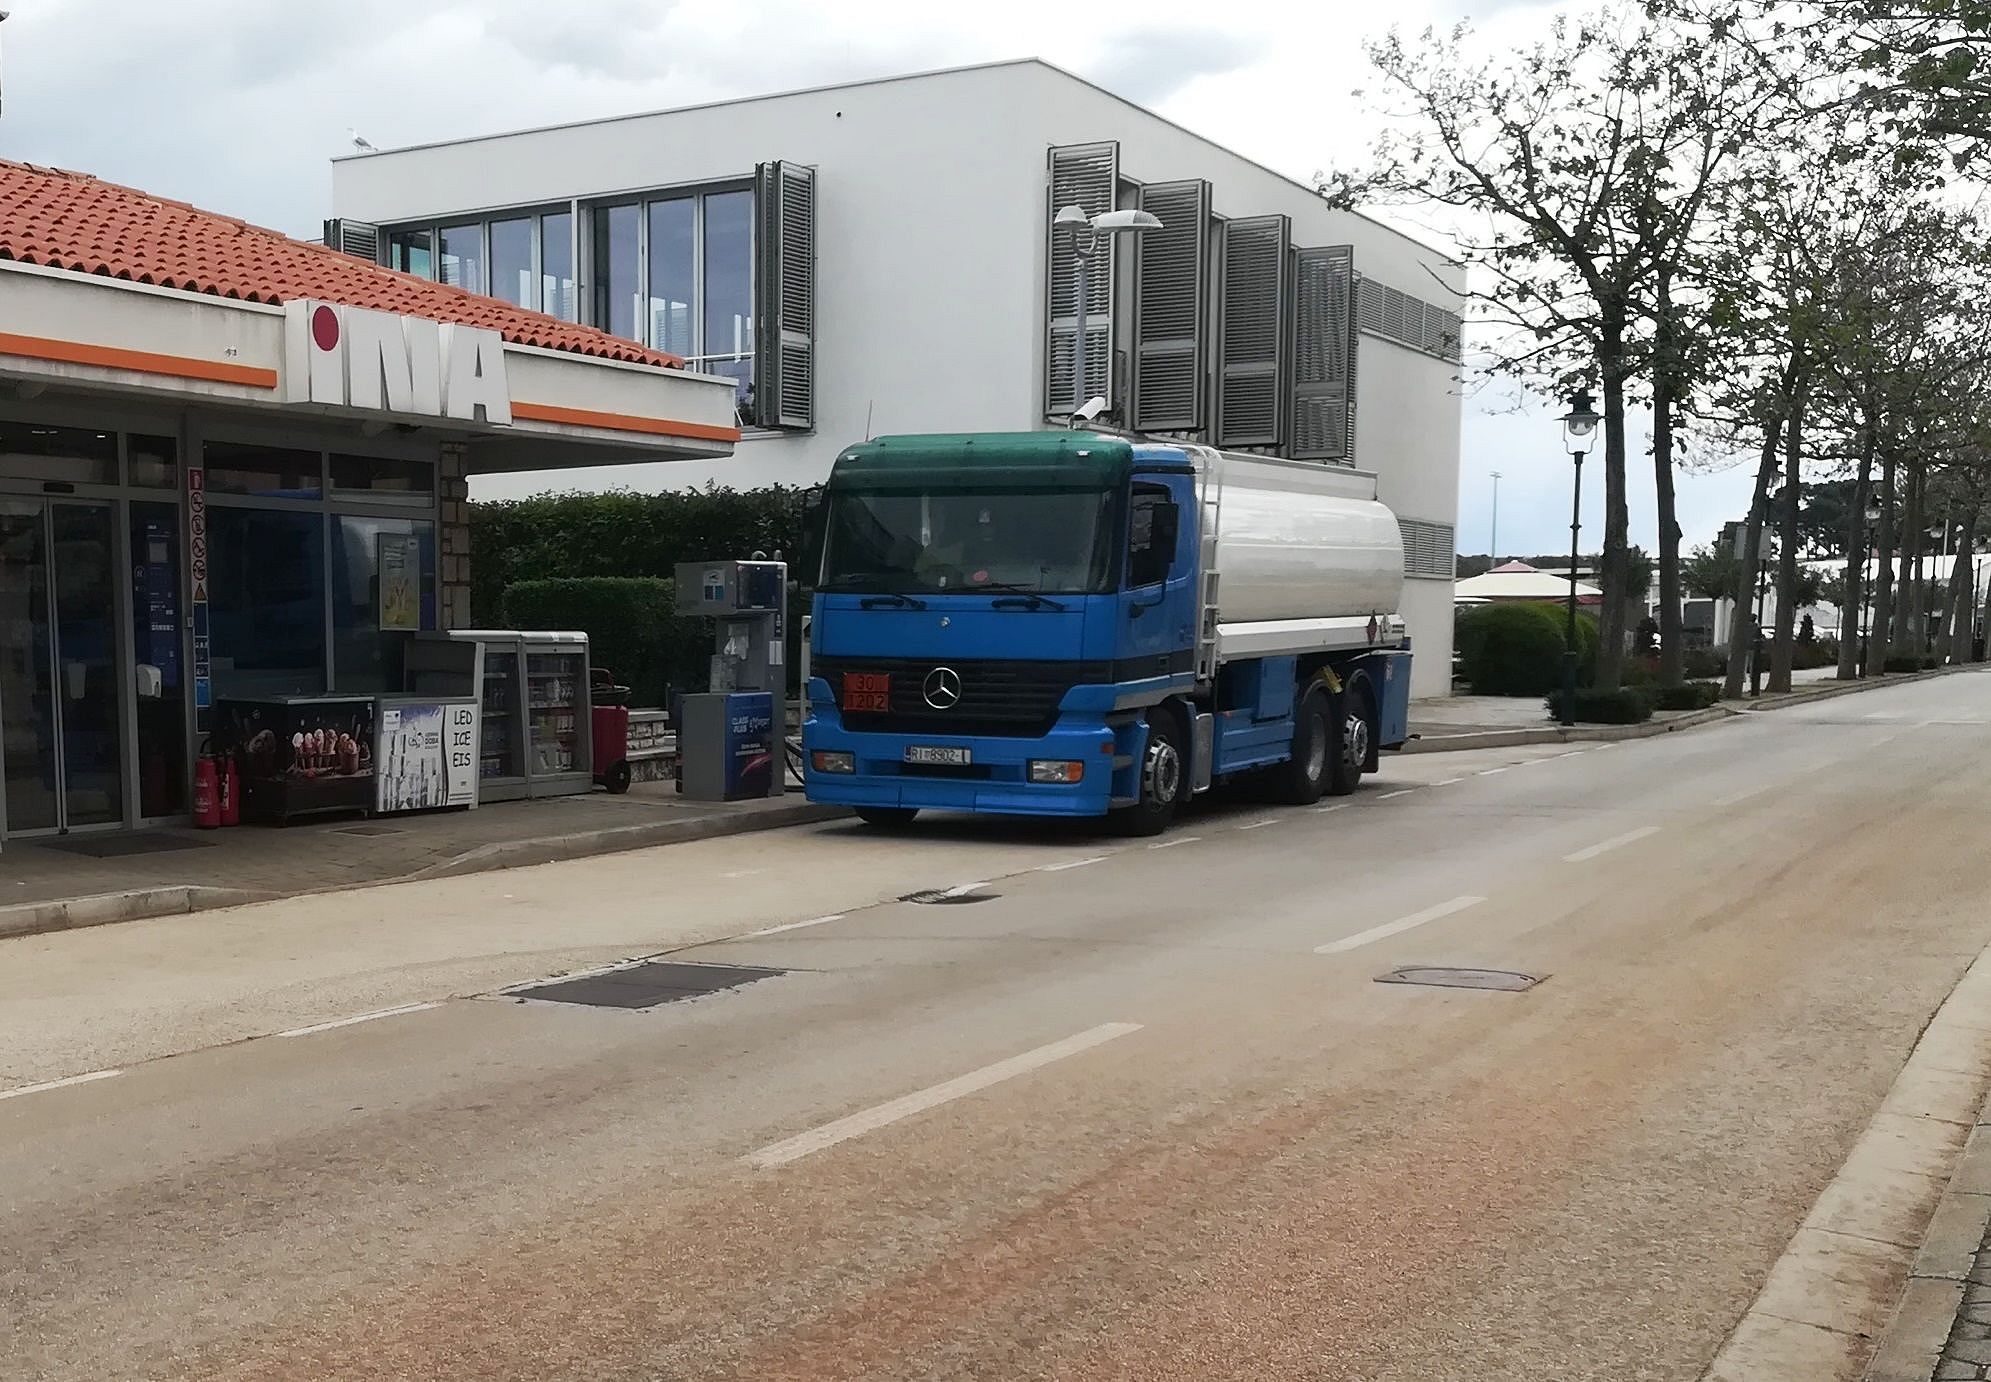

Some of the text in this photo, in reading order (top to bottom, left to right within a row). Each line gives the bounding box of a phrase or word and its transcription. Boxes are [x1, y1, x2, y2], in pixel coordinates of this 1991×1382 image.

[286, 297, 513, 426] INA
[855, 675, 873, 690] 30
[848, 694, 885, 710] 1202
[454, 709, 473, 726] LED
[453, 730, 472, 747] ICE
[452, 752, 471, 768] EIS
